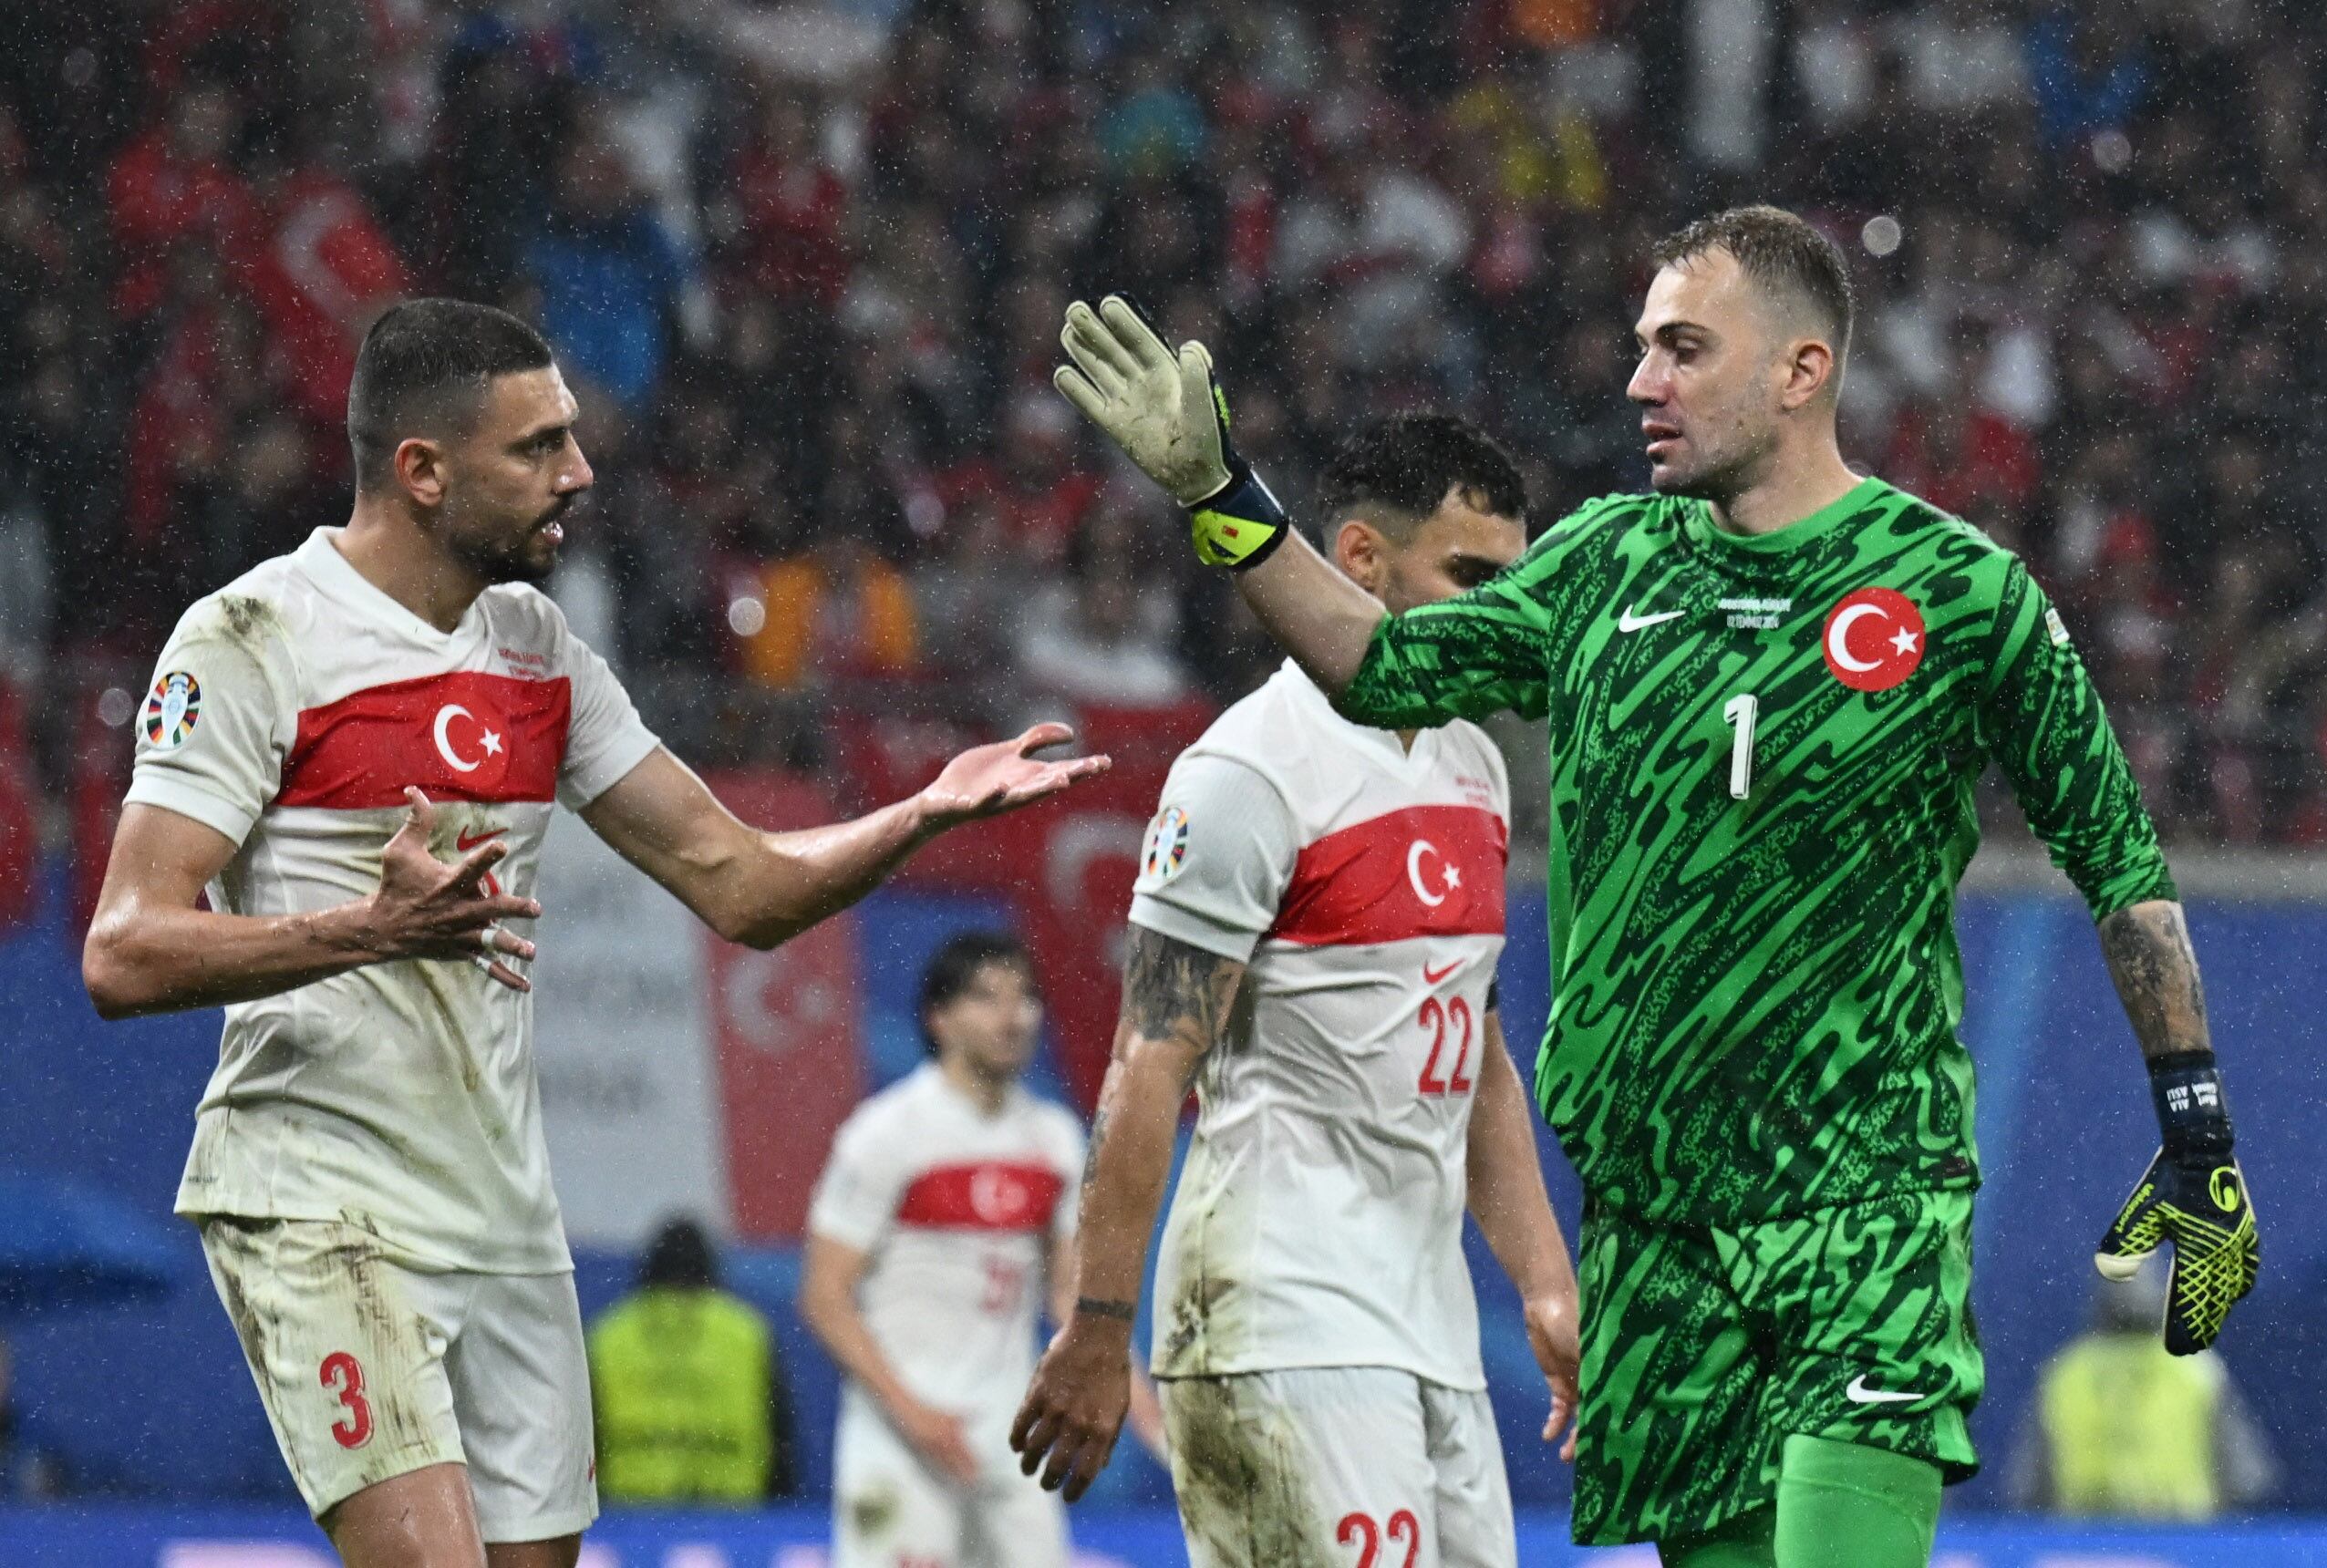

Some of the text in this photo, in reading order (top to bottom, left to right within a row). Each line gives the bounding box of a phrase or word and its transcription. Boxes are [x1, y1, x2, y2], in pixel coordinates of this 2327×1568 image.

[1723, 693, 1758, 800] 1
[1418, 995, 1472, 1099] 22
[319, 1350, 375, 1450] 3
